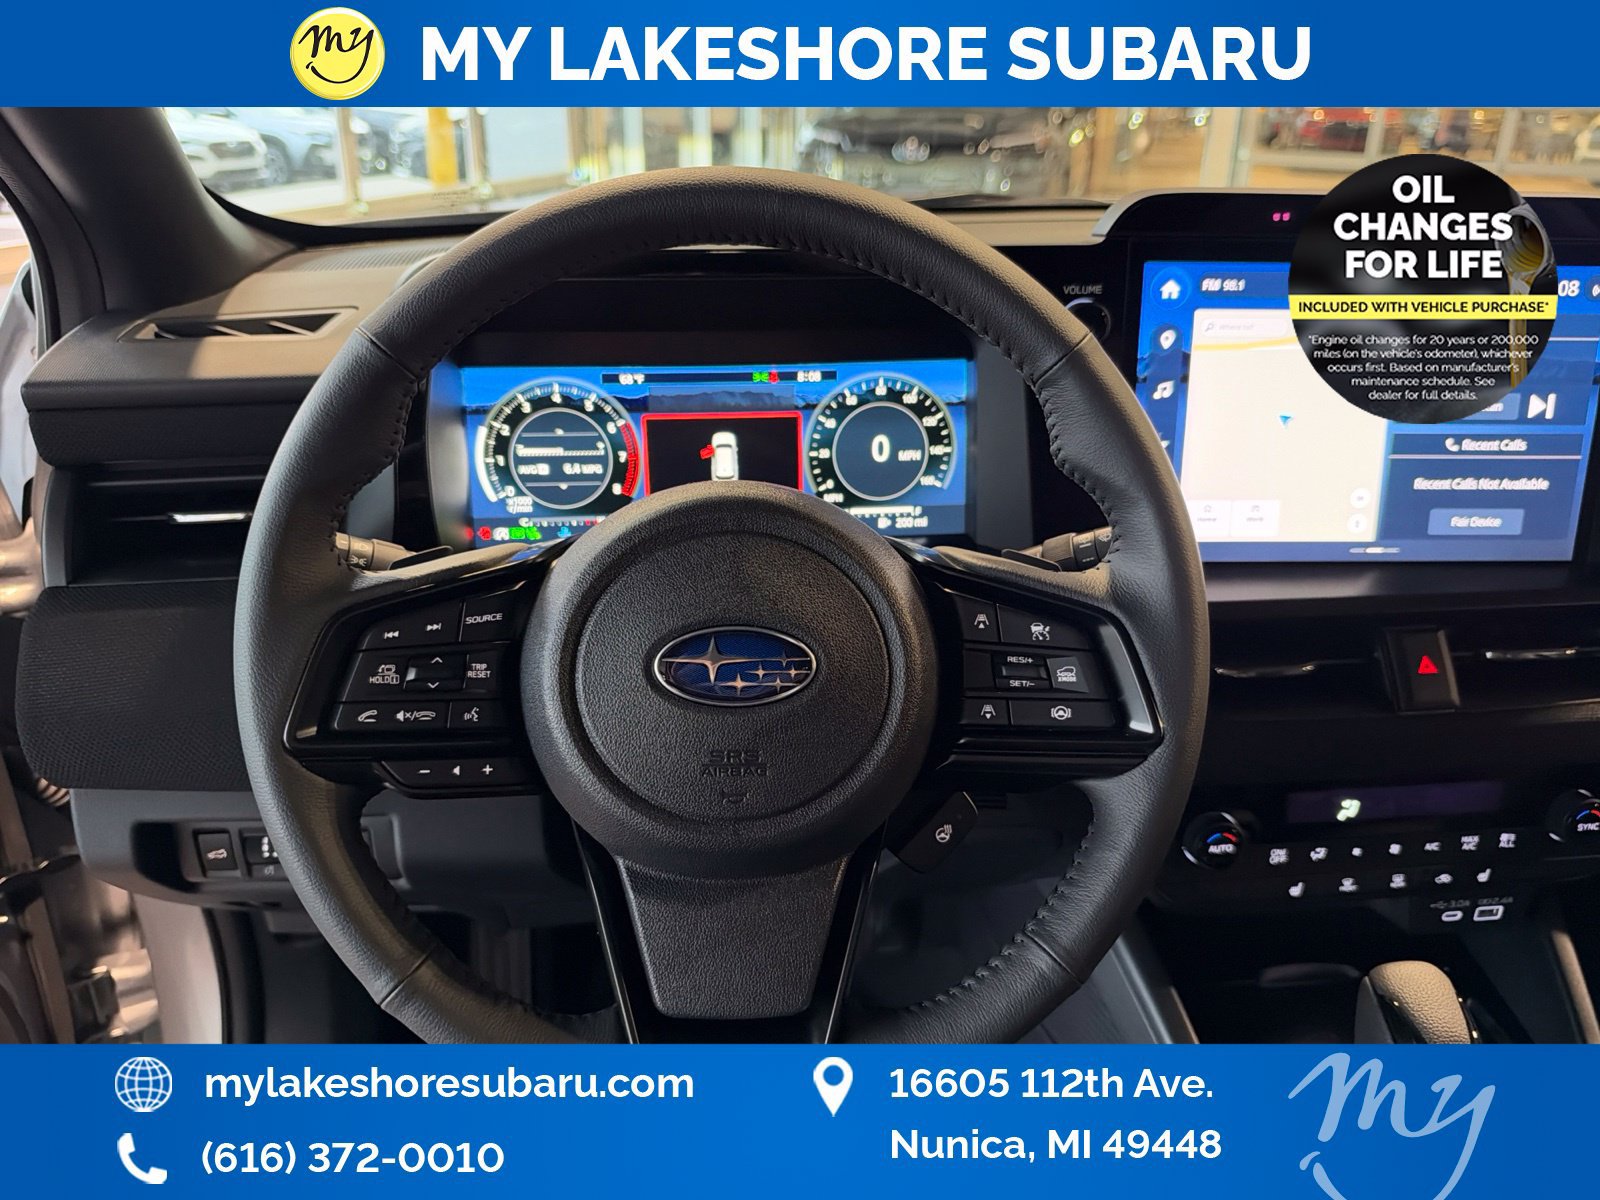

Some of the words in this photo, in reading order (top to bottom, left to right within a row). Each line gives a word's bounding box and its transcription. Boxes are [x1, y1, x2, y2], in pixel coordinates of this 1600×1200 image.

[1063, 285, 1102, 295] VOLUME
[551, 392, 562, 403] 4
[521, 402, 532, 413] 3
[584, 400, 594, 412] 5
[500, 424, 510, 436] 2
[607, 422, 616, 434] 6
[871, 434, 890, 463] 0
[898, 450, 922, 461] MPH
[1461, 438, 1500, 451] Recent
[1500, 438, 1528, 451] Calls
[495, 455, 505, 466] 1
[617, 451, 627, 463] 7
[612, 483, 622, 495] 8
[1413, 477, 1451, 490] Recent
[1451, 477, 1478, 490] Calls
[1478, 477, 1500, 490] Not
[1500, 477, 1550, 490] Available
[505, 486, 515, 496] 0
[1470, 516, 1502, 528] Device
[465, 613, 503, 624] SOURCE
[1007, 656, 1034, 664] RES/+
[470, 663, 488, 671] TRIP
[467, 670, 491, 678] RESET
[702, 766, 769, 778] AIRBAG
[1577, 822, 1600, 832] SYNC
[1208, 844, 1237, 855] AUTO
